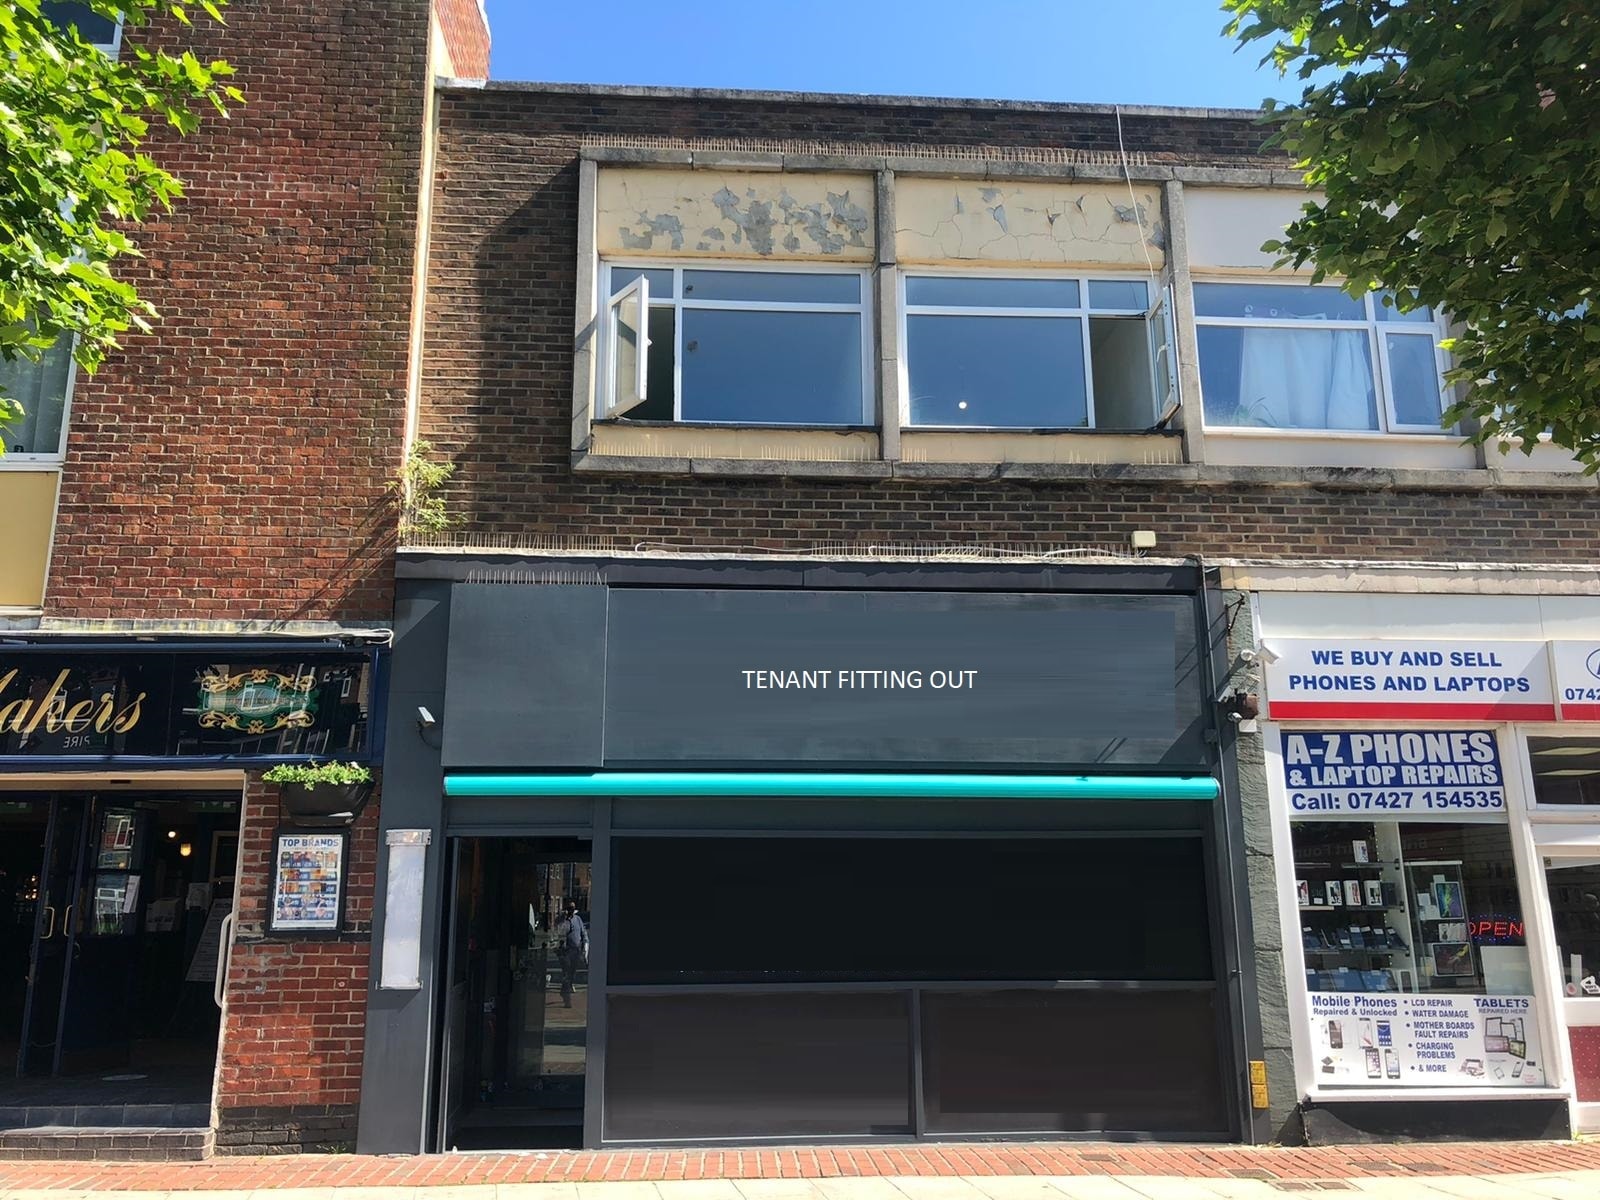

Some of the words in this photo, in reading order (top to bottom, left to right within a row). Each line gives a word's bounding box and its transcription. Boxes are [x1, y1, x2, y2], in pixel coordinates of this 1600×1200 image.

[1312, 651, 1344, 665] WE
[1351, 651, 1393, 665] BUY
[1400, 652, 1443, 666] AND
[1450, 652, 1502, 667] SELL
[1289, 675, 1376, 691] PHONES
[1383, 676, 1427, 691] AND
[1434, 677, 1530, 692] LAPTOPS
[0, 668, 147, 734] akers
[1287, 734, 1344, 765] A-Z
[1350, 732, 1495, 764] PHONES
[1289, 769, 1307, 786] &
[1311, 765, 1396, 786] LAPTOP
[1401, 764, 1499, 785] REPAIRS
[1291, 793, 1341, 810] Call:
[1347, 792, 1414, 809] 07427
[1422, 790, 1503, 808] 154535
[282, 839, 300, 847] TOP
[302, 839, 339, 847] BRANDS
[1312, 996, 1350, 1007] Mobile
[1354, 997, 1397, 1008] Phones
[1473, 998, 1529, 1008] TABLETS
[1313, 1008, 1348, 1016] Repaired
[1360, 1009, 1397, 1017] Unlocked
[1412, 1010, 1437, 1018] WATER
[1439, 1010, 1469, 1018] DAMAGE
[1446, 1022, 1475, 1030] BOARDS
[1438, 1031, 1469, 1039] REPAIRS
[1416, 1042, 1454, 1050] CHARGING
[1417, 1051, 1456, 1059] PROBLEMS
